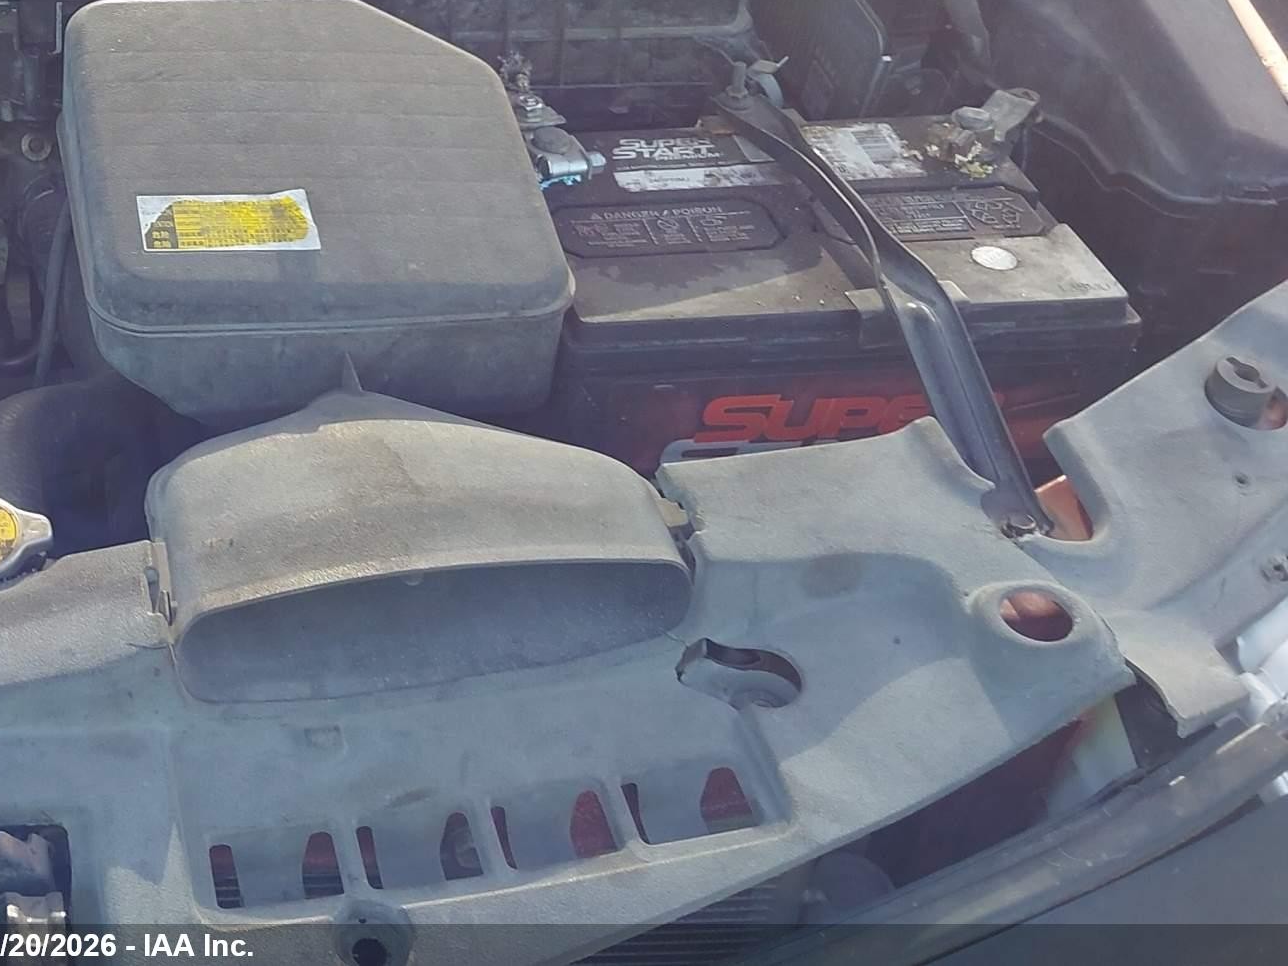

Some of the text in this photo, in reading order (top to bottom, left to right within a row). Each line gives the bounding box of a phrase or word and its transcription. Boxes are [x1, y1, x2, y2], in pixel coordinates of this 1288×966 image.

[619, 137, 716, 149] SUPER
[612, 147, 708, 160] START
[693, 393, 928, 443] SUPE
